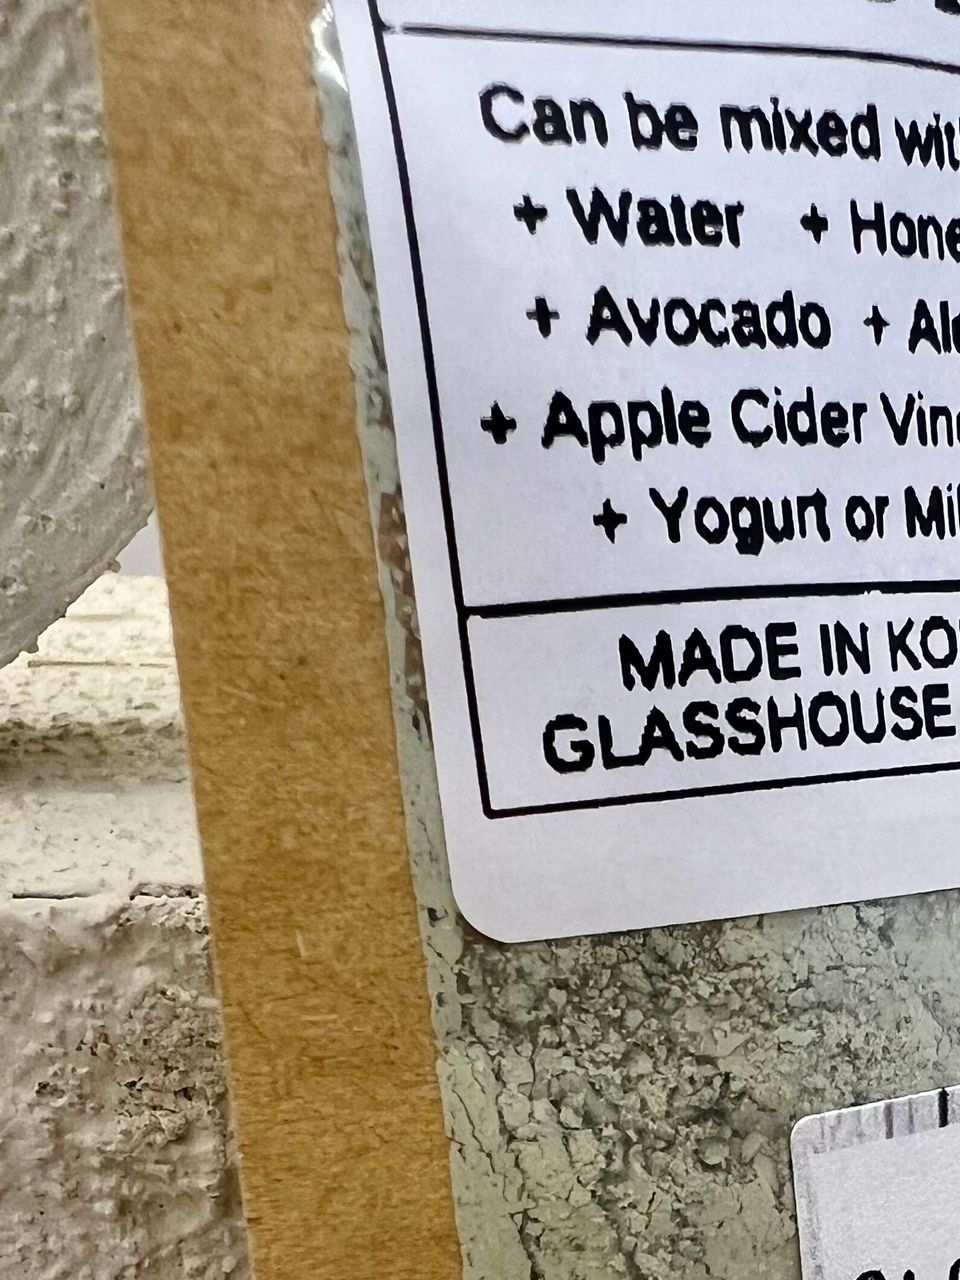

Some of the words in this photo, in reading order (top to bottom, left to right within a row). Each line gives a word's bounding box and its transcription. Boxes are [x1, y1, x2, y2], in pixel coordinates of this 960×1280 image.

[480, 85, 608, 147] Can
[624, 92, 698, 151] be
[720, 97, 881, 161] mixed
[514, 195, 547, 235] +
[566, 187, 744, 248] Water
[800, 203, 828, 244] +
[526, 297, 559, 338] +
[586, 286, 831, 349] Avocado
[864, 305, 890, 345] +
[481, 401, 517, 444] +
[541, 386, 711, 465] Apple
[731, 386, 867, 448] Cider
[593, 498, 627, 544] +
[649, 486, 830, 556] Yogurt
[846, 496, 889, 542] or
[619, 622, 801, 691] MADE
[820, 621, 870, 676] IN
[543, 684, 956, 774] GLASSHOUSE
